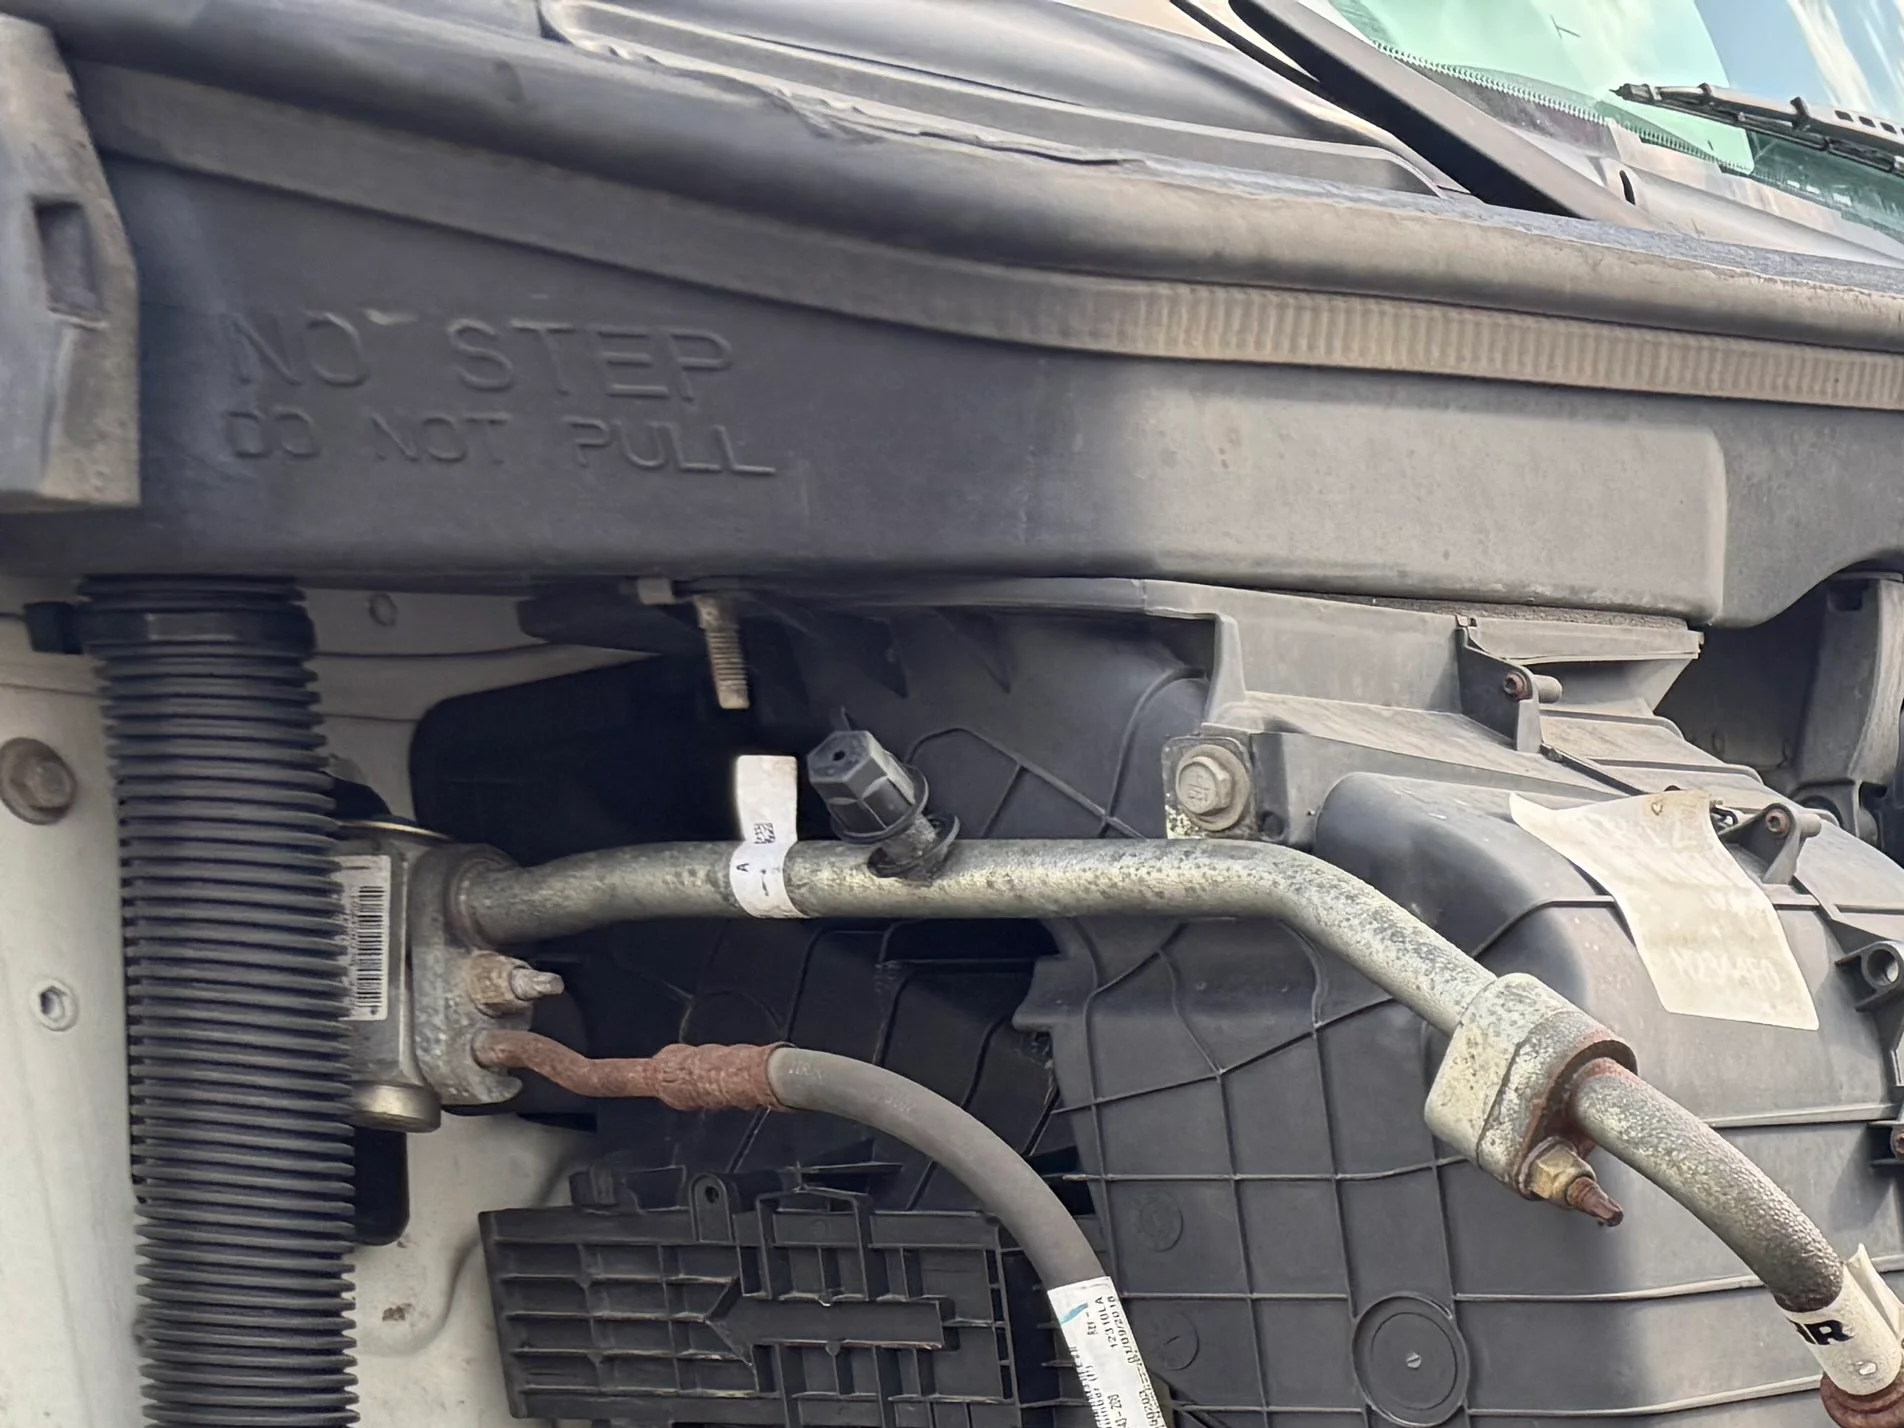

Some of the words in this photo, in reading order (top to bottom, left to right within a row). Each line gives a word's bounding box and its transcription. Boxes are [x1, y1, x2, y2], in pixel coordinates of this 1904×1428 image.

[229, 309, 371, 388] NO
[449, 316, 733, 403] STEP
[224, 409, 322, 459] DO
[371, 409, 507, 465] NOT
[573, 416, 778, 477] PULL
